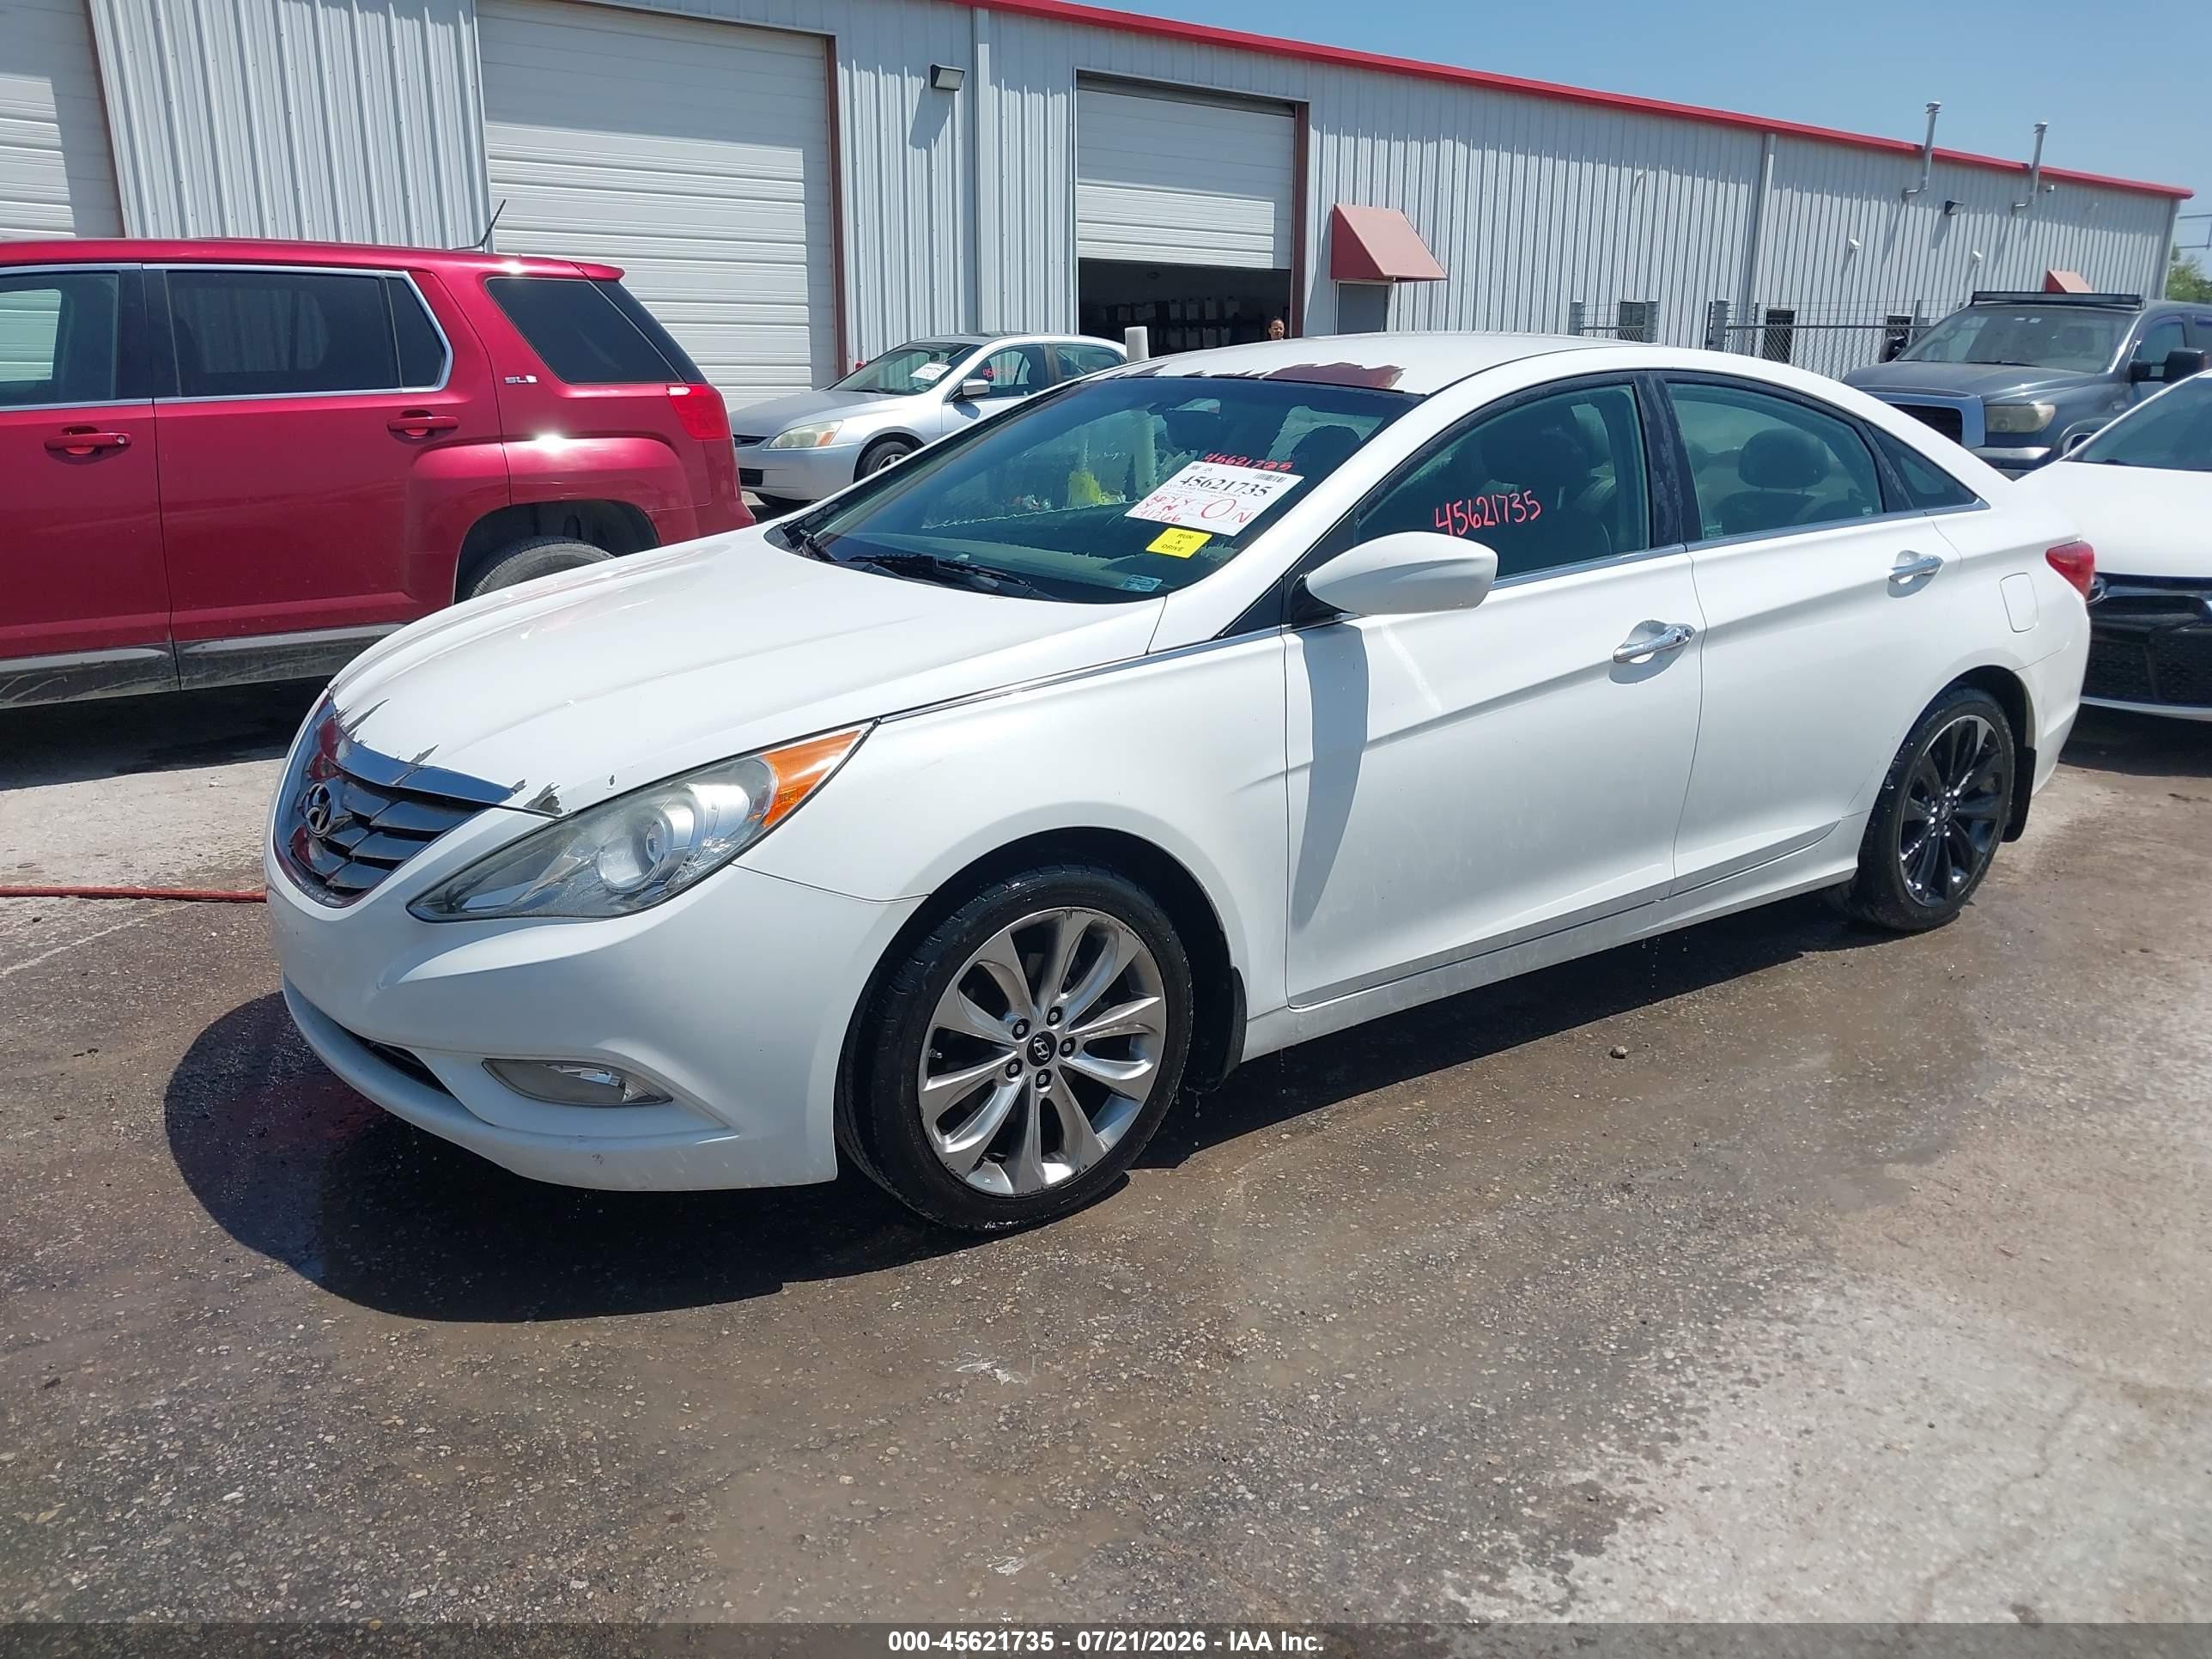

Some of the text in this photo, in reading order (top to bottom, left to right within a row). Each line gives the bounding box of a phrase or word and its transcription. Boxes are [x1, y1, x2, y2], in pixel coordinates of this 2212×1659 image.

[1180, 475, 1273, 497] 45621735
[1435, 490, 1542, 536] 45621735
[1161, 544, 1186, 552] DRIVE
